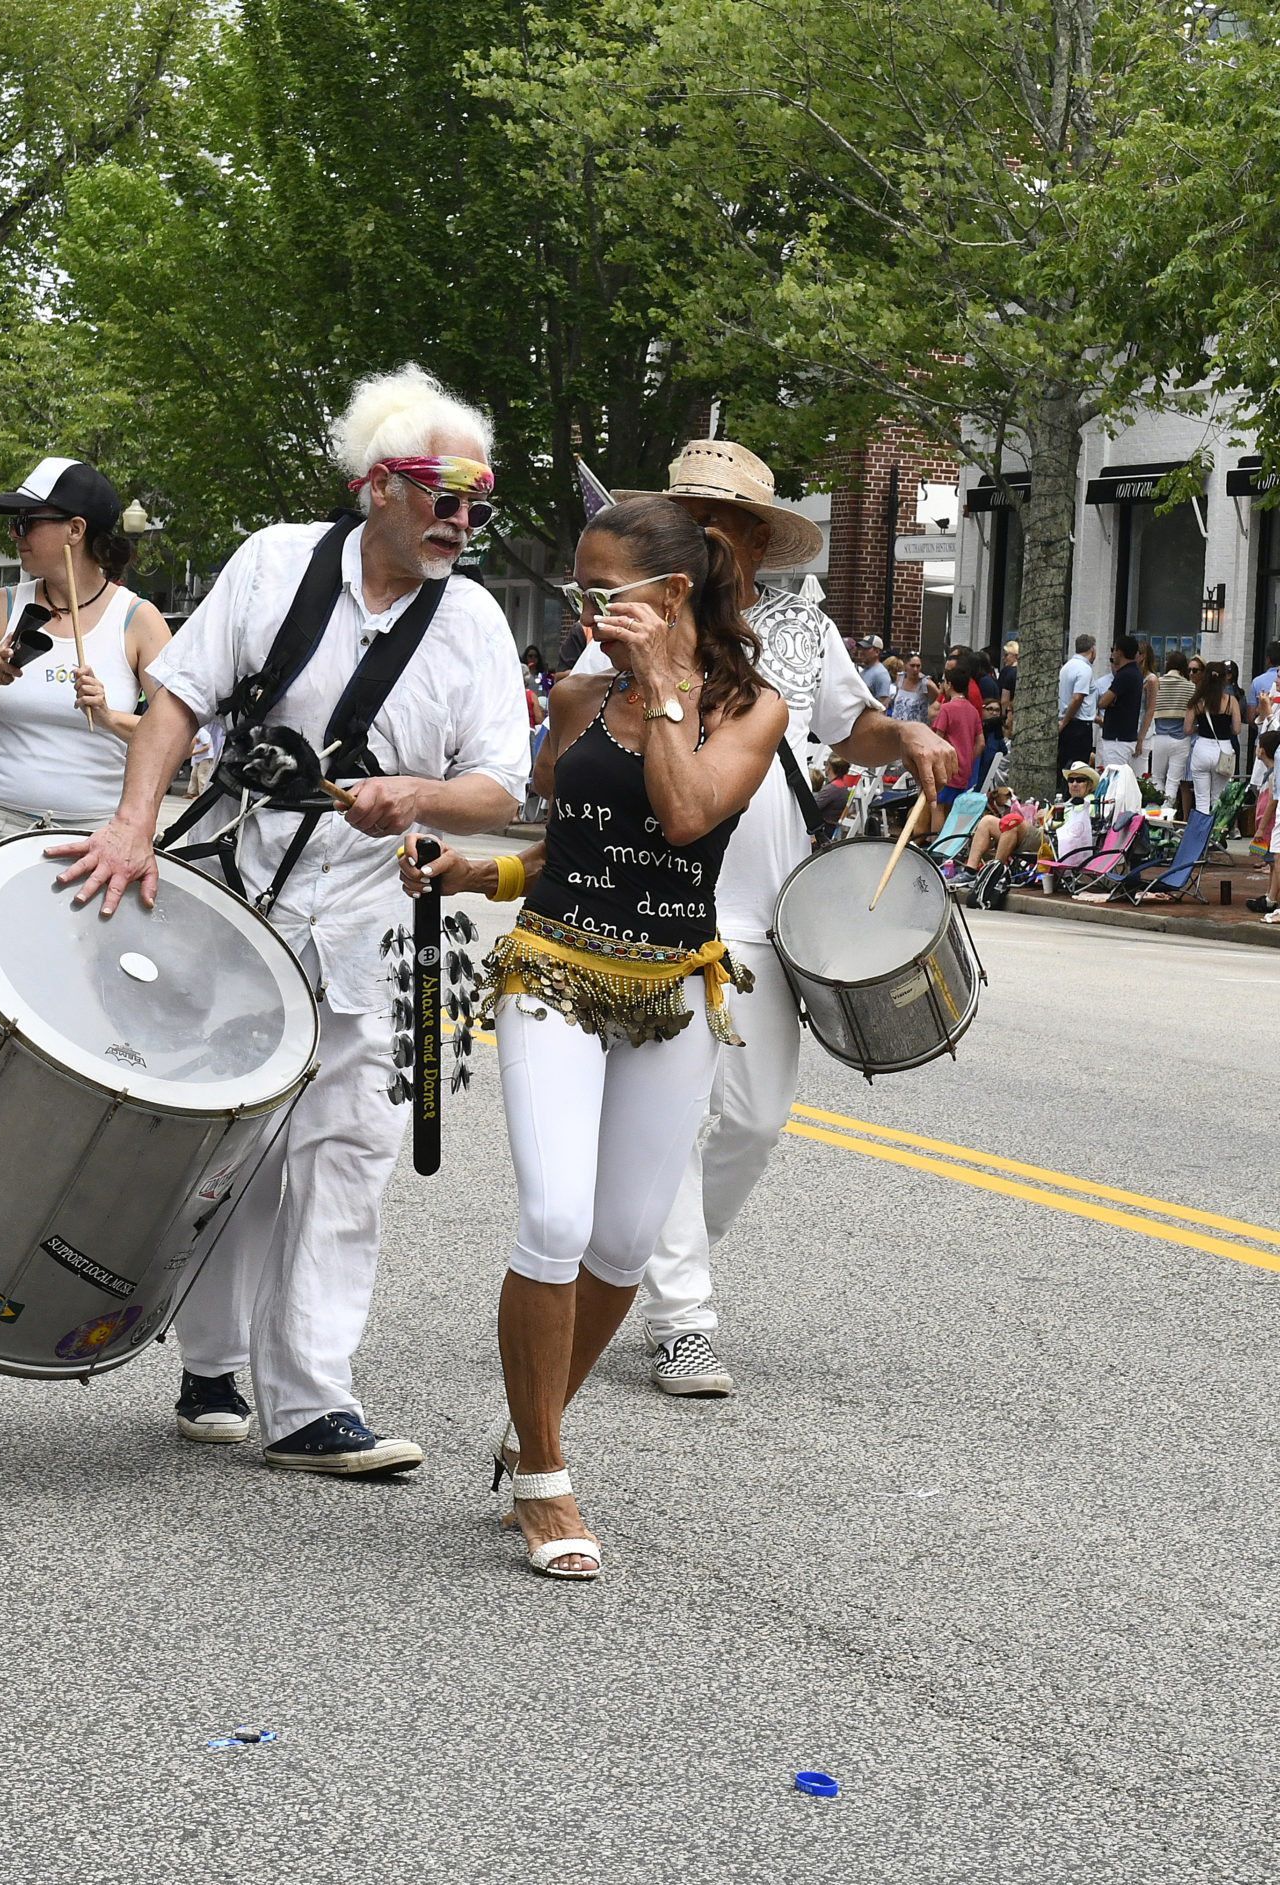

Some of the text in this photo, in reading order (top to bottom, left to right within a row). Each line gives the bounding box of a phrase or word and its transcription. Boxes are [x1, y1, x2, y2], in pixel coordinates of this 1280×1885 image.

[568, 866, 616, 889] and
[604, 845, 703, 887] moving
[637, 891, 707, 918] dance
[563, 905, 651, 946] dance
[422, 973, 439, 1120] Shake and Dance
[47, 1238, 90, 1269] SUPPORT
[83, 1260, 112, 1284] LOCAL
[109, 1278, 136, 1295] MUSIC
